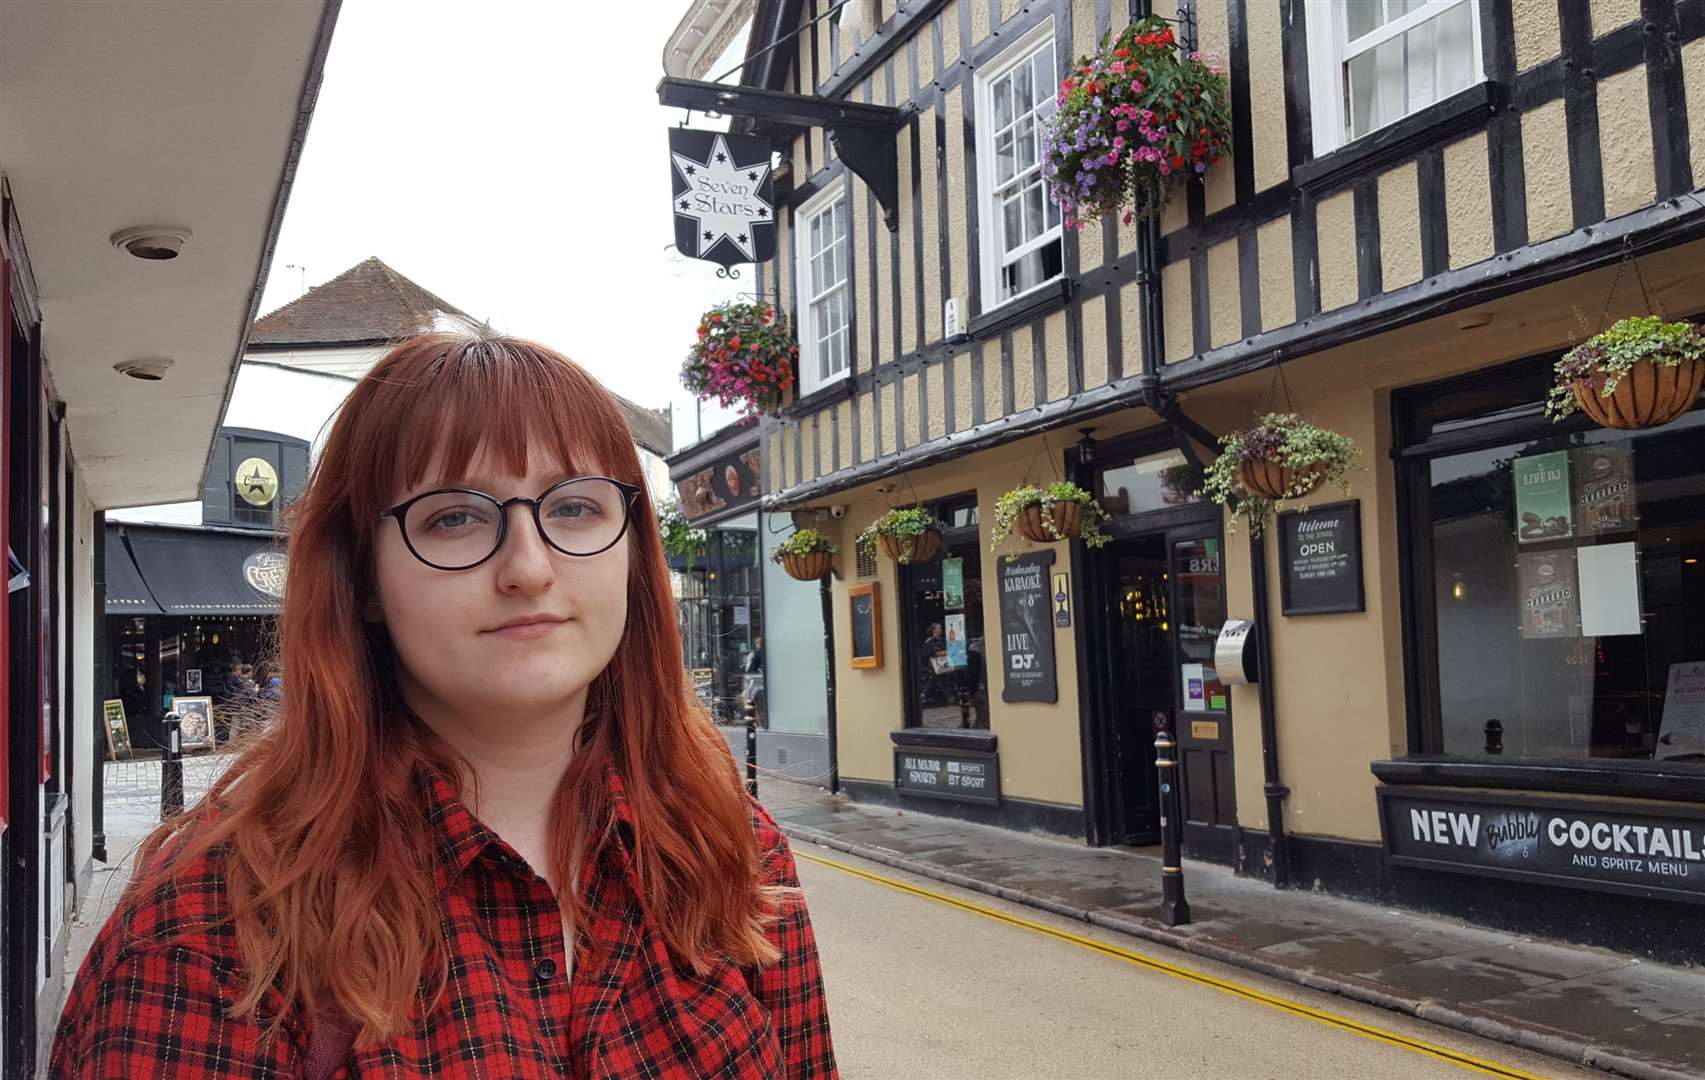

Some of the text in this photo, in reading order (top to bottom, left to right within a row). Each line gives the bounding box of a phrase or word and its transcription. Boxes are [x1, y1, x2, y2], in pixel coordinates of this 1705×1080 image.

[697, 175, 748, 200] Seven
[695, 193, 753, 216] Stars
[1523, 469, 1560, 485] LIVE DJ
[1300, 541, 1335, 556] OPEN
[1004, 574, 1041, 592] KARAOKE
[1007, 633, 1028, 651] LIVE
[904, 757, 917, 769] ALL
[918, 758, 941, 772] MAJOR
[910, 770, 937, 785] SPORTS
[948, 774, 985, 788] BT SPORT
[1410, 808, 1705, 860] NEW Bubbly COCKTAIL
[1572, 854, 1688, 876] AND SPRITZ MENU
